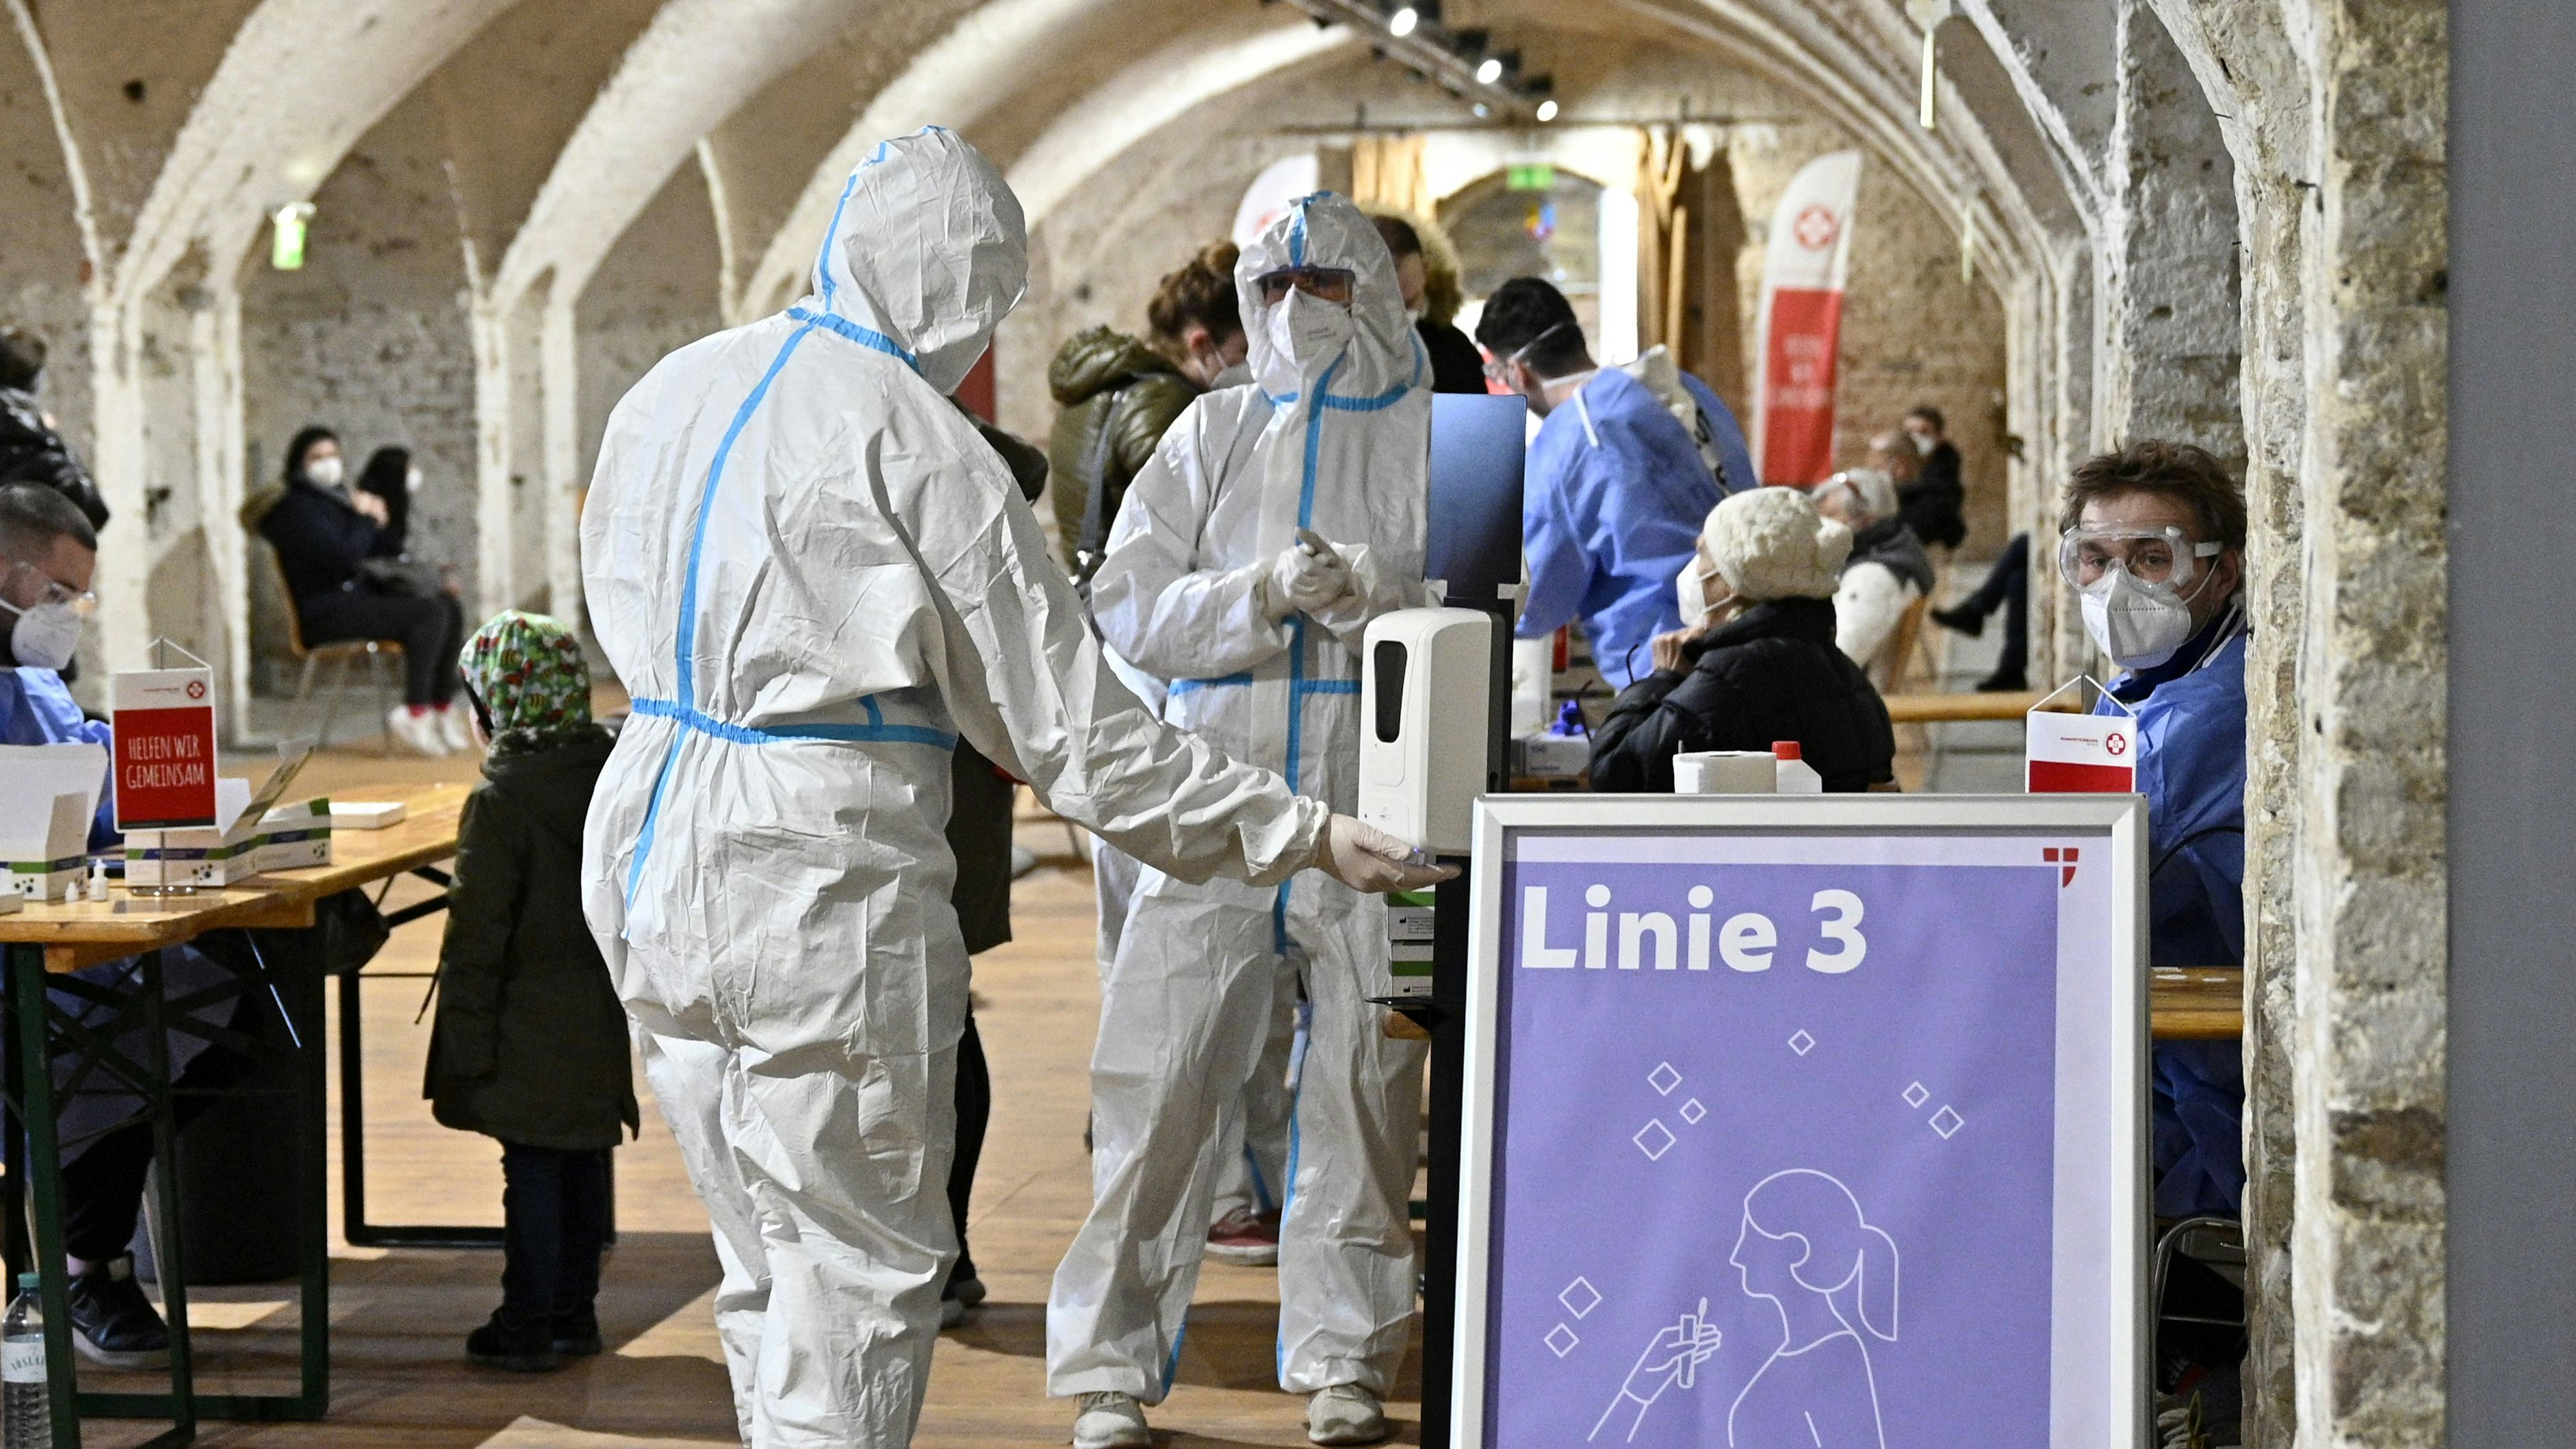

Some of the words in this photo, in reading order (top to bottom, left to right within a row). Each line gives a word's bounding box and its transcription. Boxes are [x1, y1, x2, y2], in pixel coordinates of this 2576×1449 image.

[129, 736, 171, 760] HELFEN
[174, 734, 201, 758] WIR
[125, 762, 205, 788] GEMEINSAM
[1521, 884, 1777, 973] Linie
[1805, 889, 1868, 974] 3
